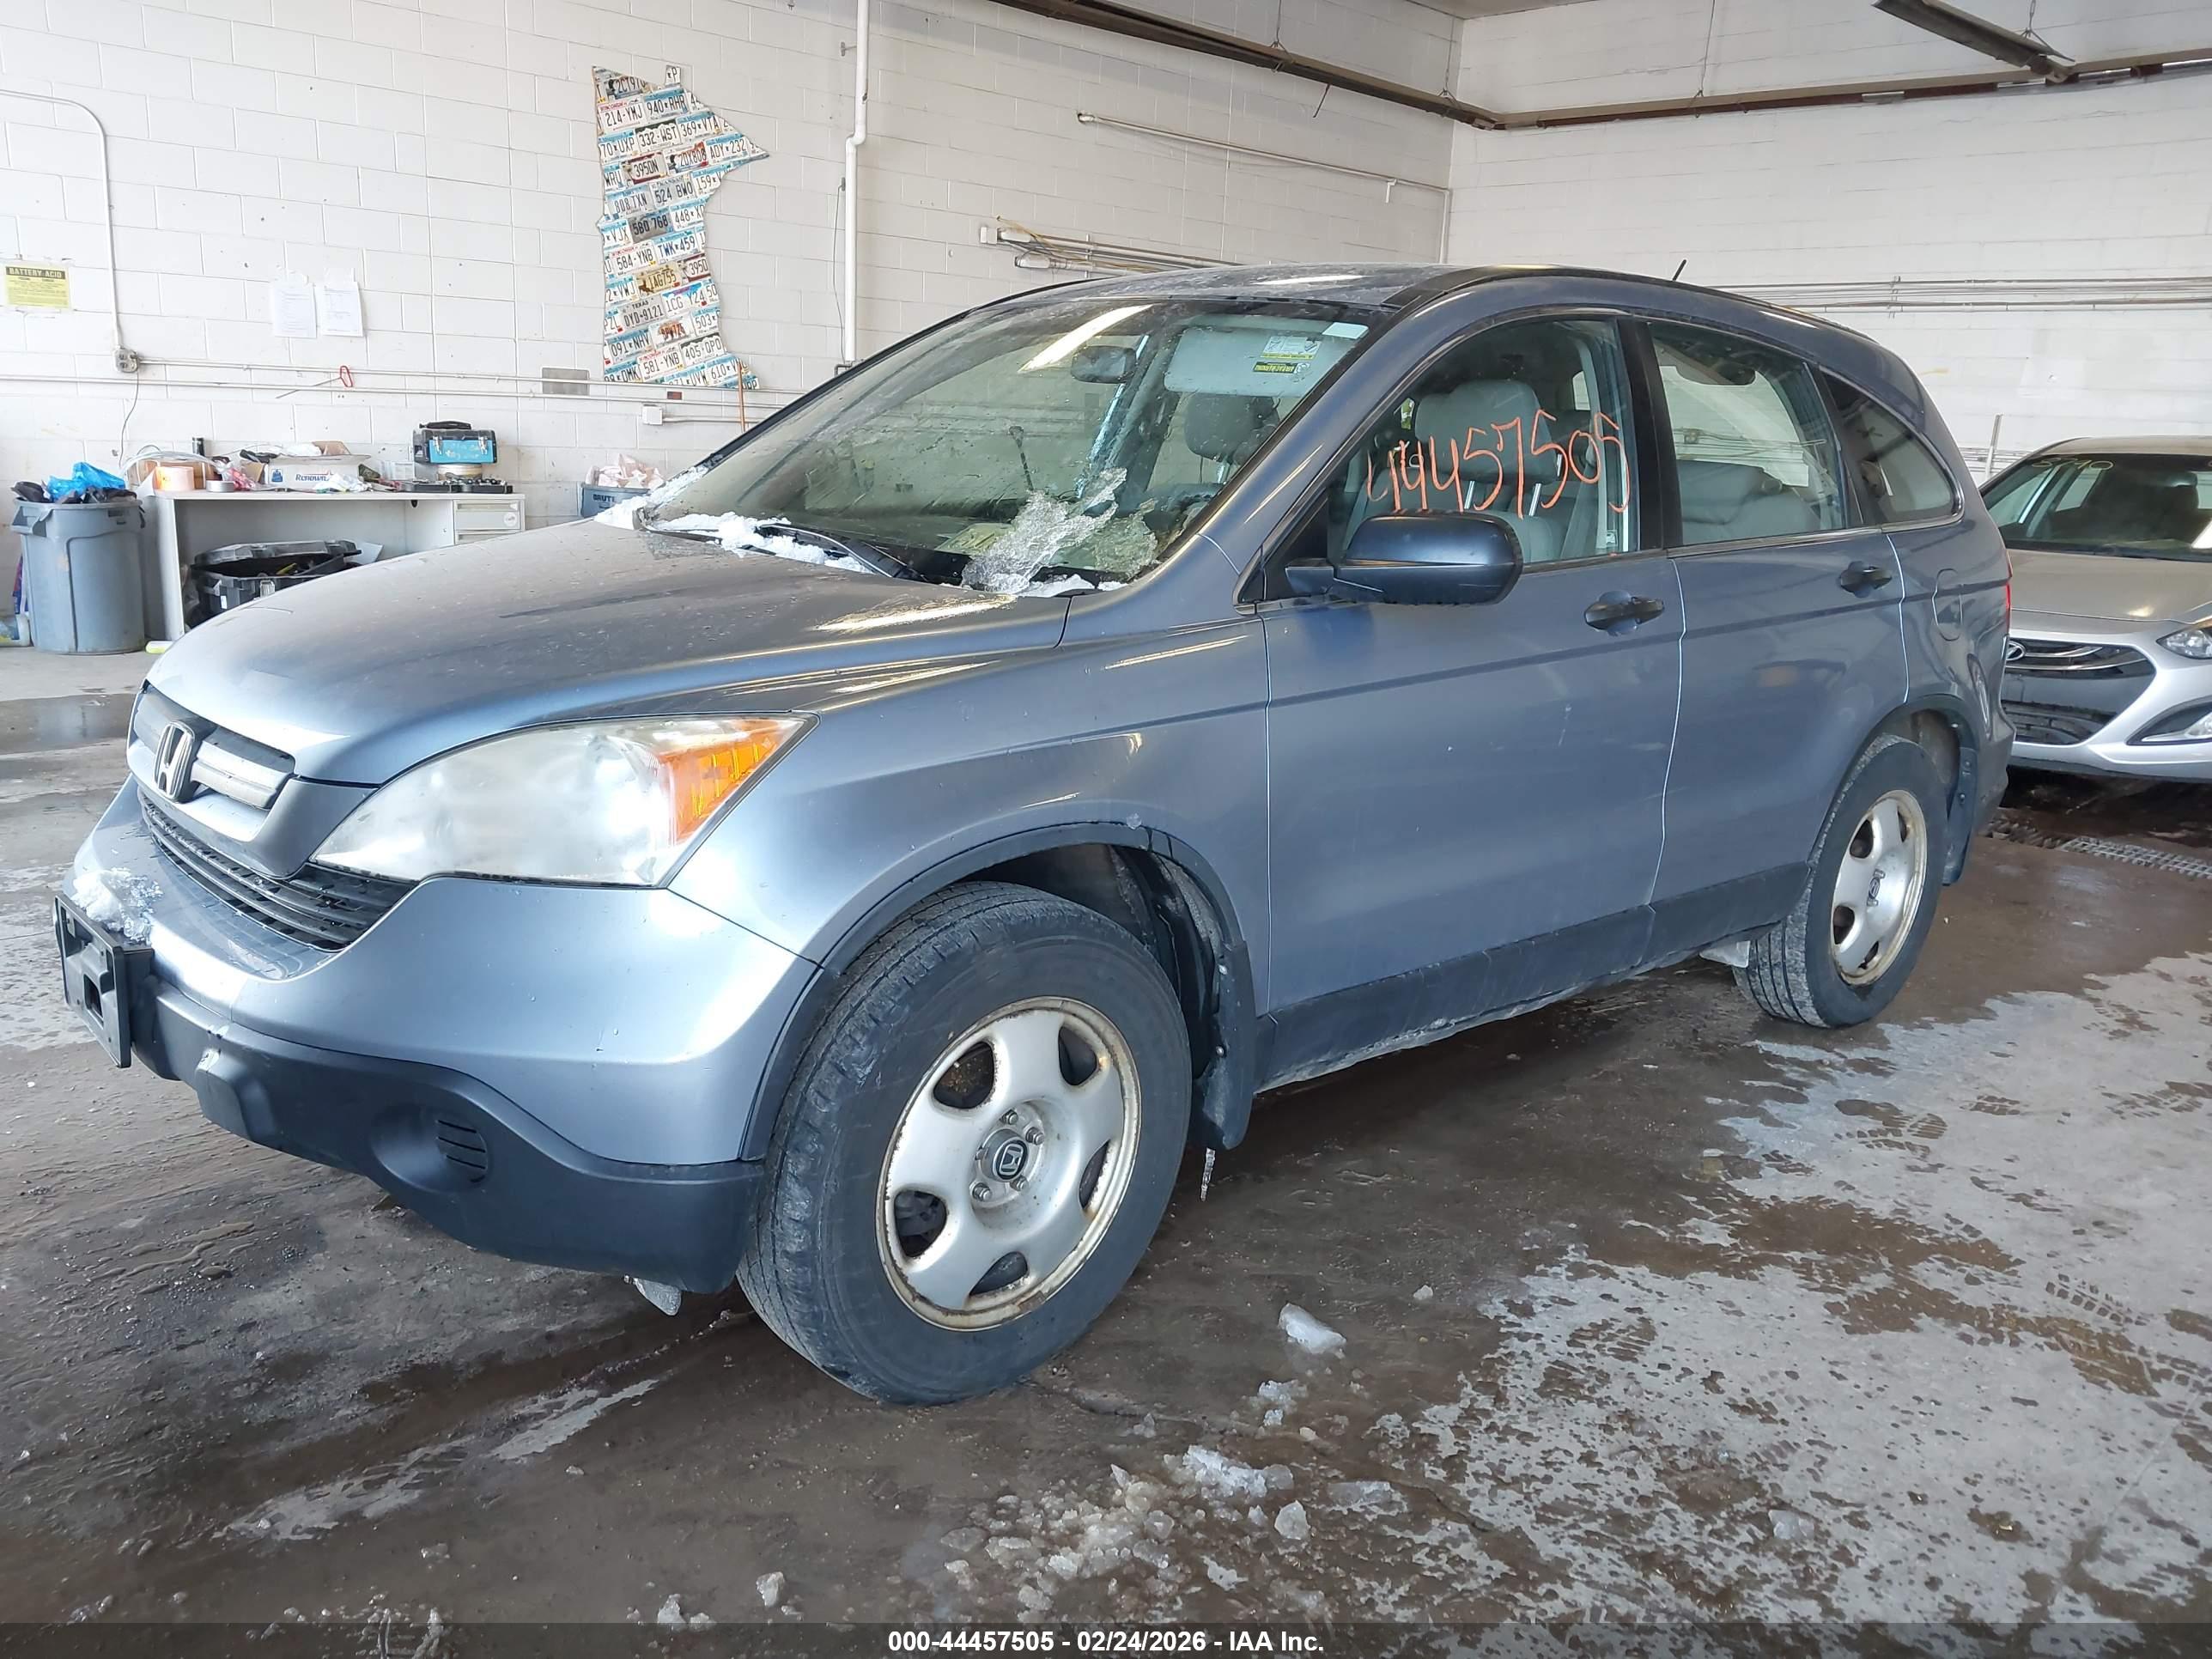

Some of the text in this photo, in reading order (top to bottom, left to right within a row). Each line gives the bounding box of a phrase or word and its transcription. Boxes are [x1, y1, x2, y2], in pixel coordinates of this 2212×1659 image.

[651, 214, 669, 229] 768
[9, 267, 63, 279] BATTERY ACID
